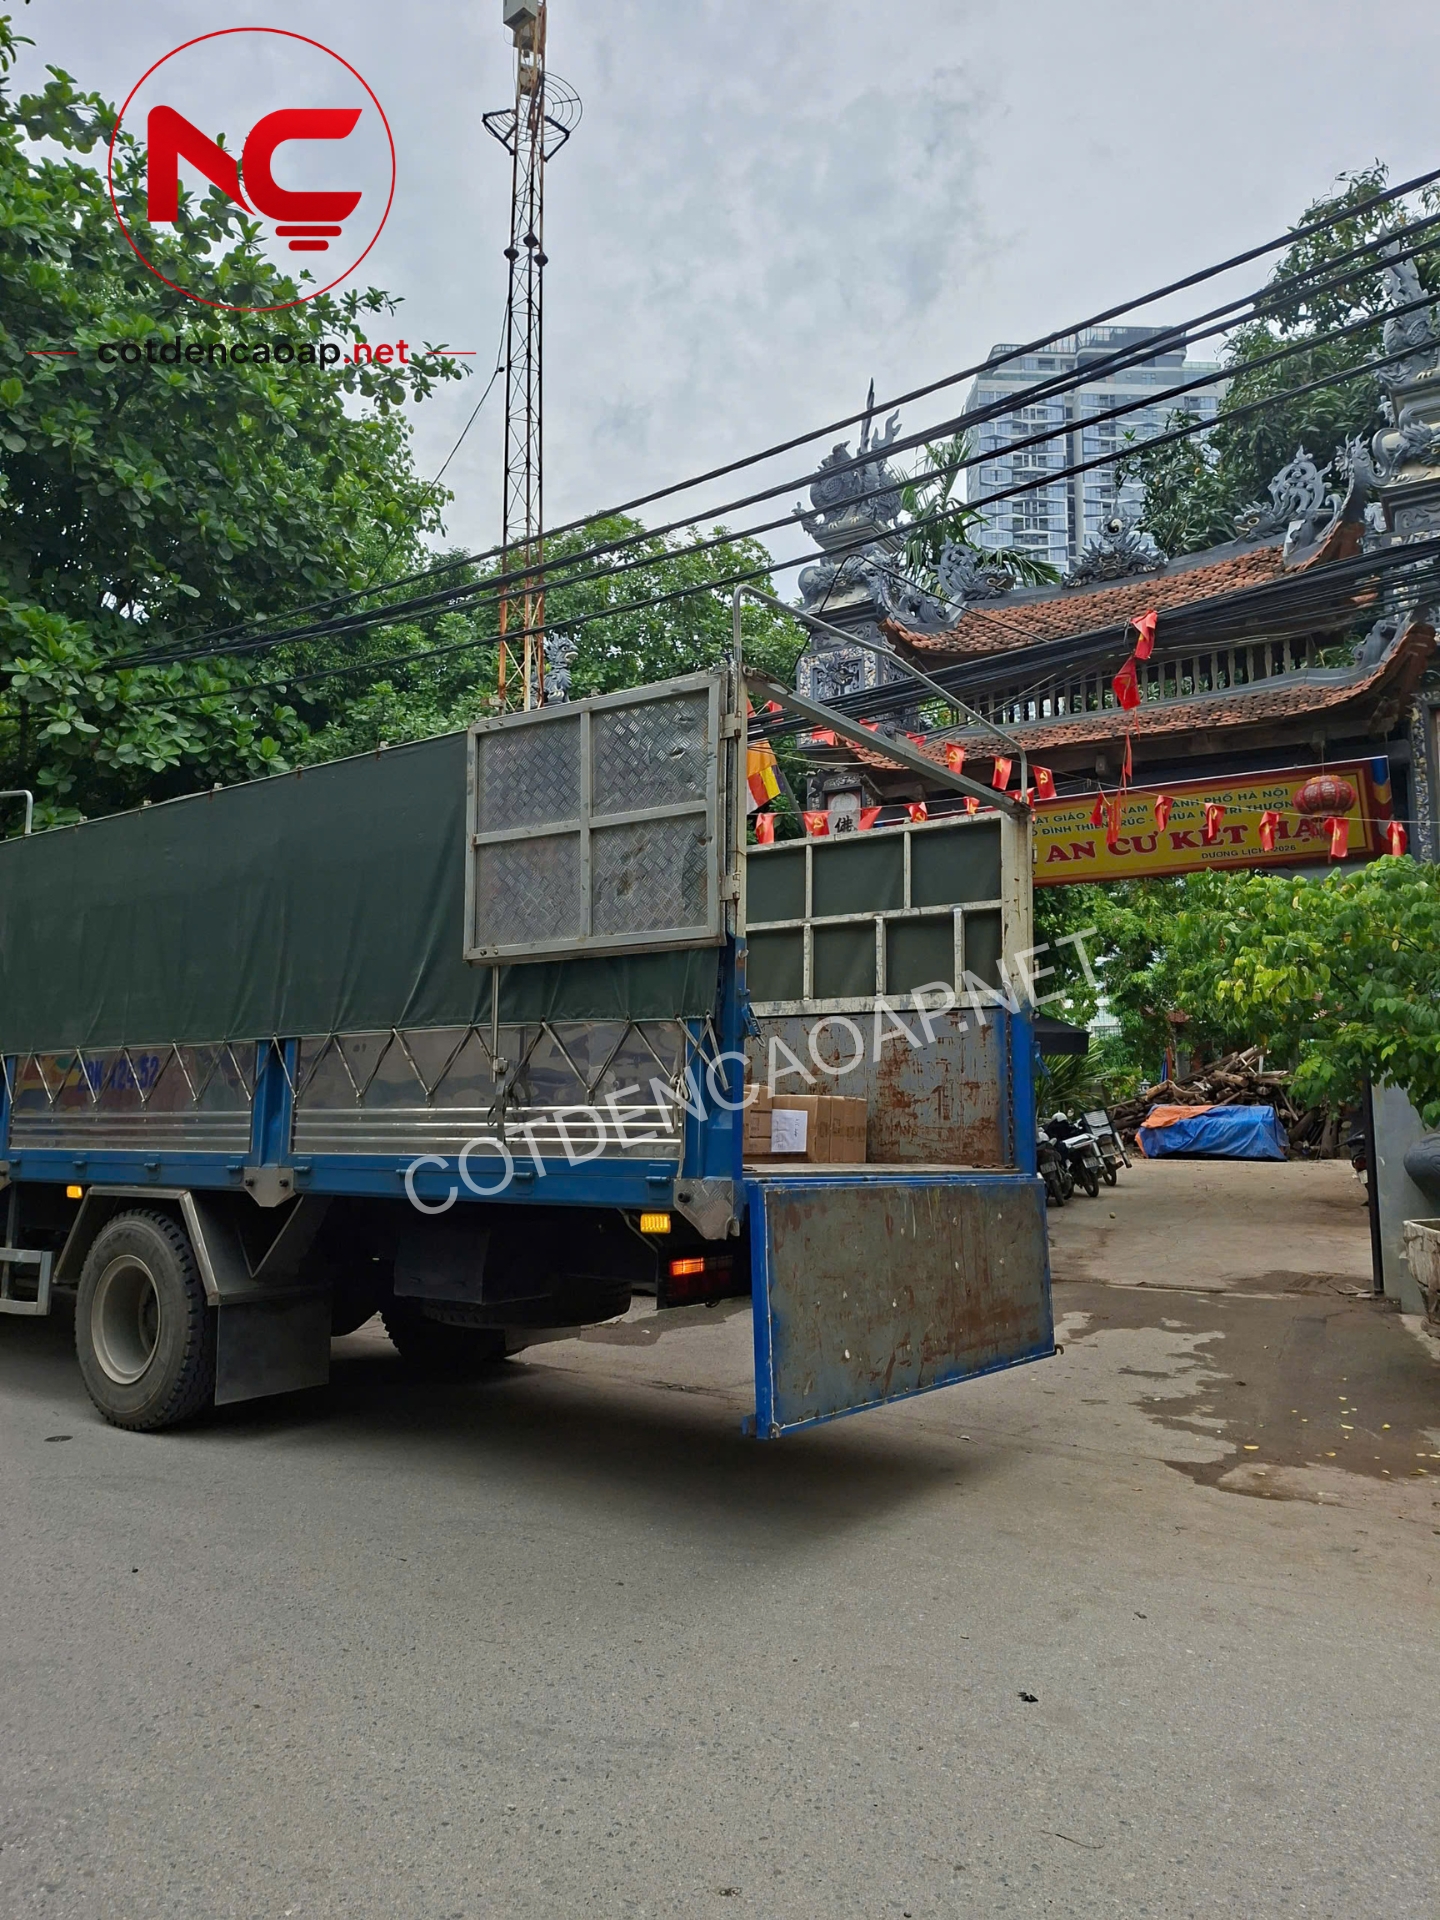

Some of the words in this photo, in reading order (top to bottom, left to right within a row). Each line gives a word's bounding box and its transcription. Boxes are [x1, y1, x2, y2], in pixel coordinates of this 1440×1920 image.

[1042, 825, 1071, 835] ĐÌNH
[1120, 816, 1146, 827] RÚC
[1168, 810, 1195, 821] HÙA
[1246, 800, 1294, 812] THƯỢN
[1053, 811, 1086, 822] GIÁO
[1238, 790, 1258, 801] HÀ
[1263, 787, 1289, 798] NỘI
[834, 814, 858, 833] 佛
[1045, 840, 1096, 863] AN
[1108, 830, 1159, 856] CƯ
